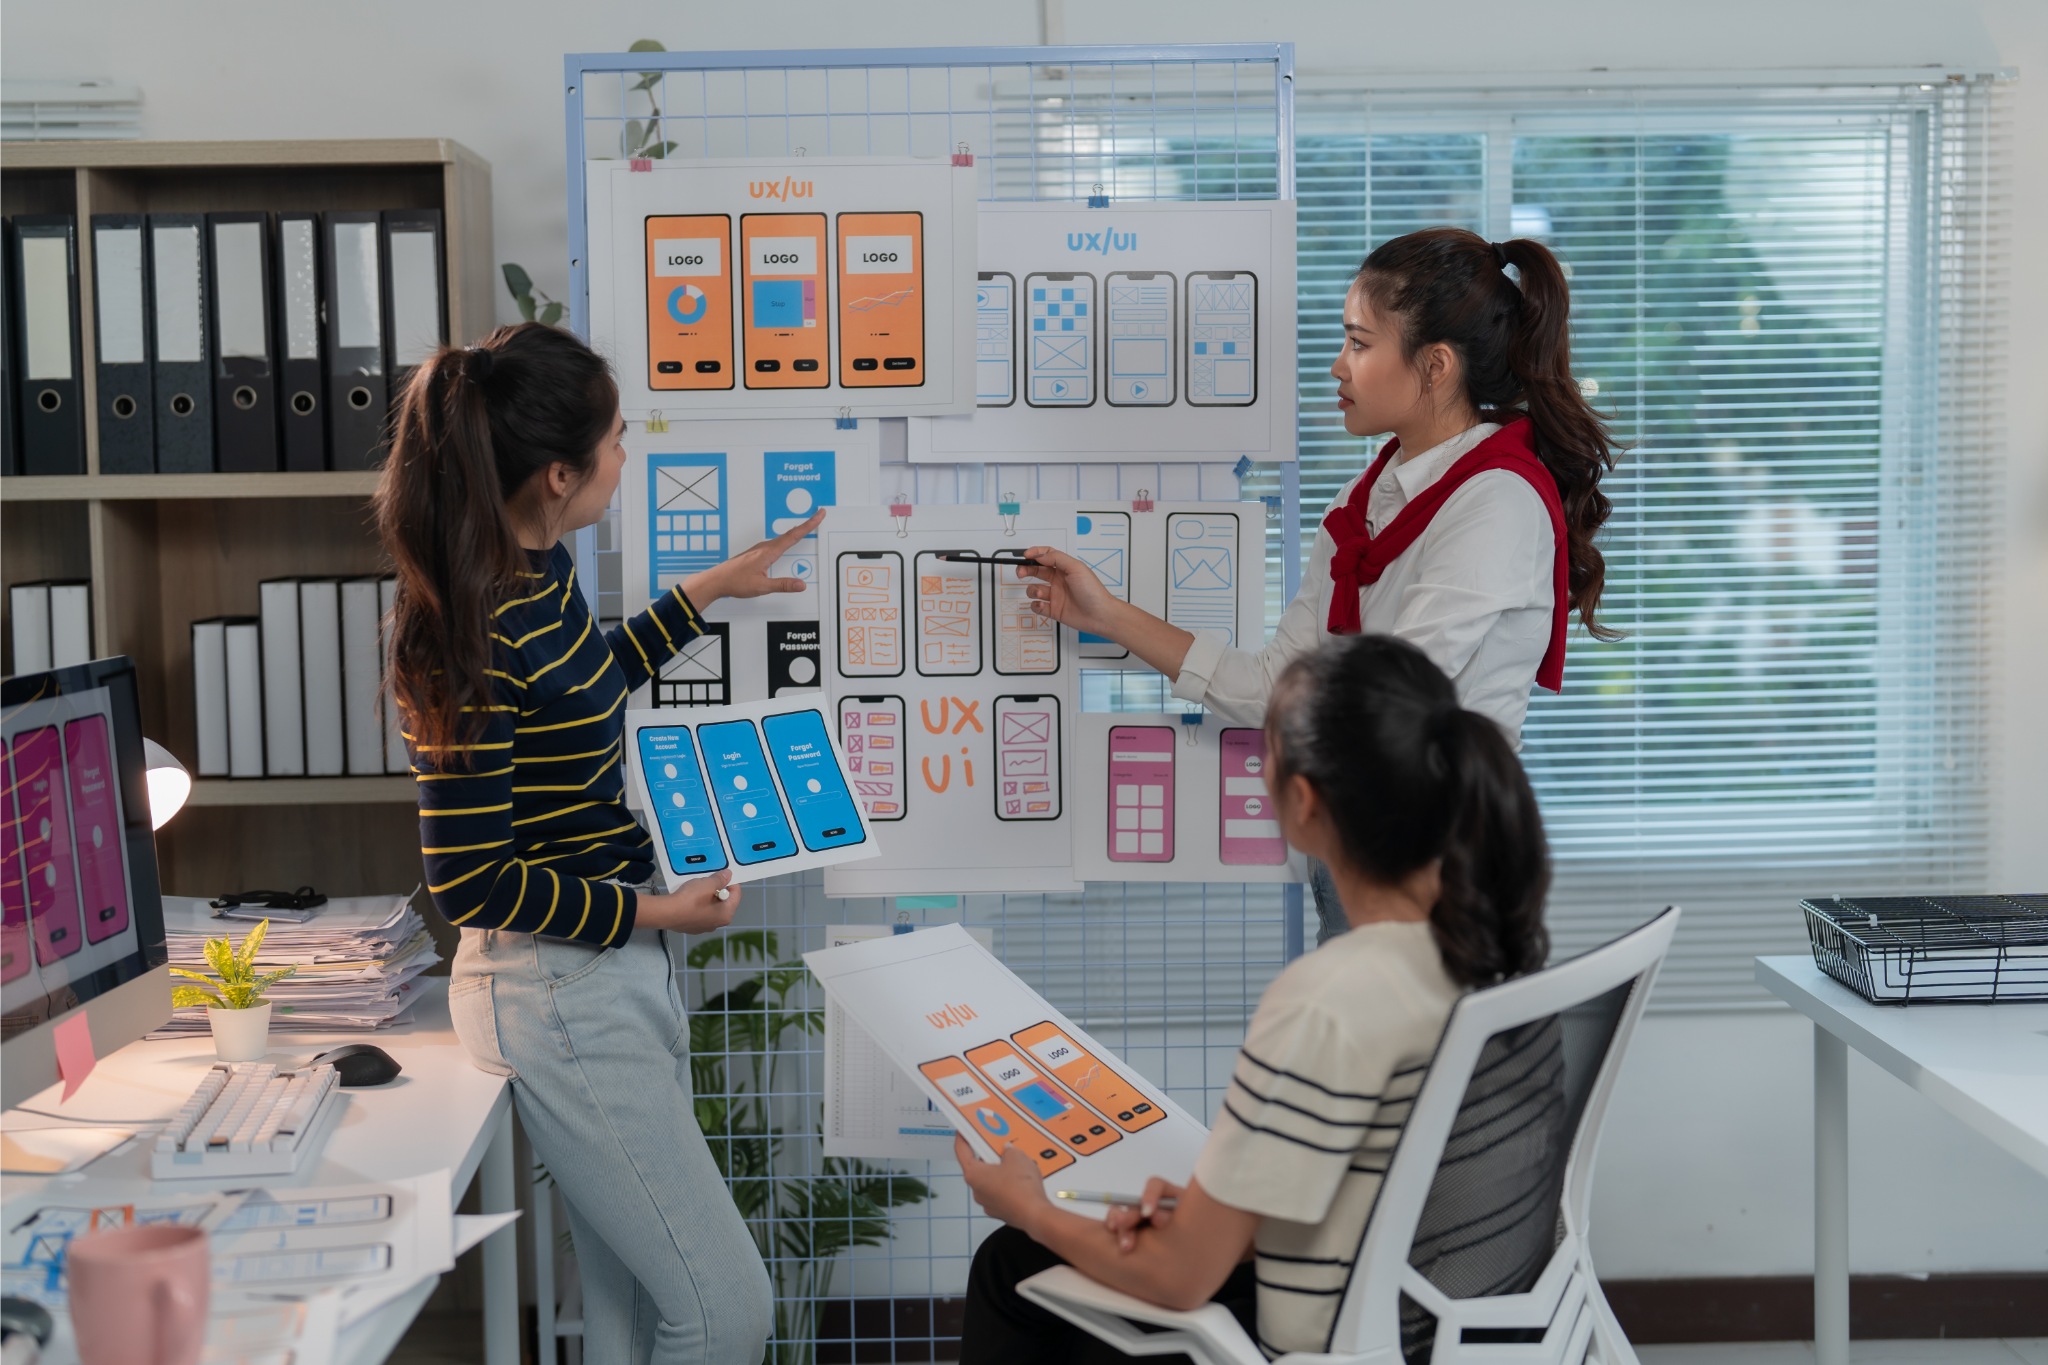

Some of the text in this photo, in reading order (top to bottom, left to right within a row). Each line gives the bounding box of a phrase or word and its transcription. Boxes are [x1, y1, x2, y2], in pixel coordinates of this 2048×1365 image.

[749, 176, 814, 202] UX/UI
[1067, 227, 1137, 256] UX/UI
[668, 254, 704, 266] LOGO
[763, 253, 799, 265] LOGO
[862, 252, 898, 264] LOGO
[784, 463, 813, 473] Forgot
[777, 473, 821, 482] Password
[787, 632, 816, 641] Forgot
[920, 696, 984, 735] UX
[790, 743, 813, 752] Forgot
[722, 751, 741, 761] Login
[788, 751, 821, 761] Password
[83, 766, 100, 780] Forgot
[81, 779, 105, 795] Password
[925, 1003, 979, 1029] UX/UI
[1048, 1047, 1069, 1060] LOGO
[999, 1068, 1020, 1081] LOGO
[953, 1086, 973, 1097] LOGO
